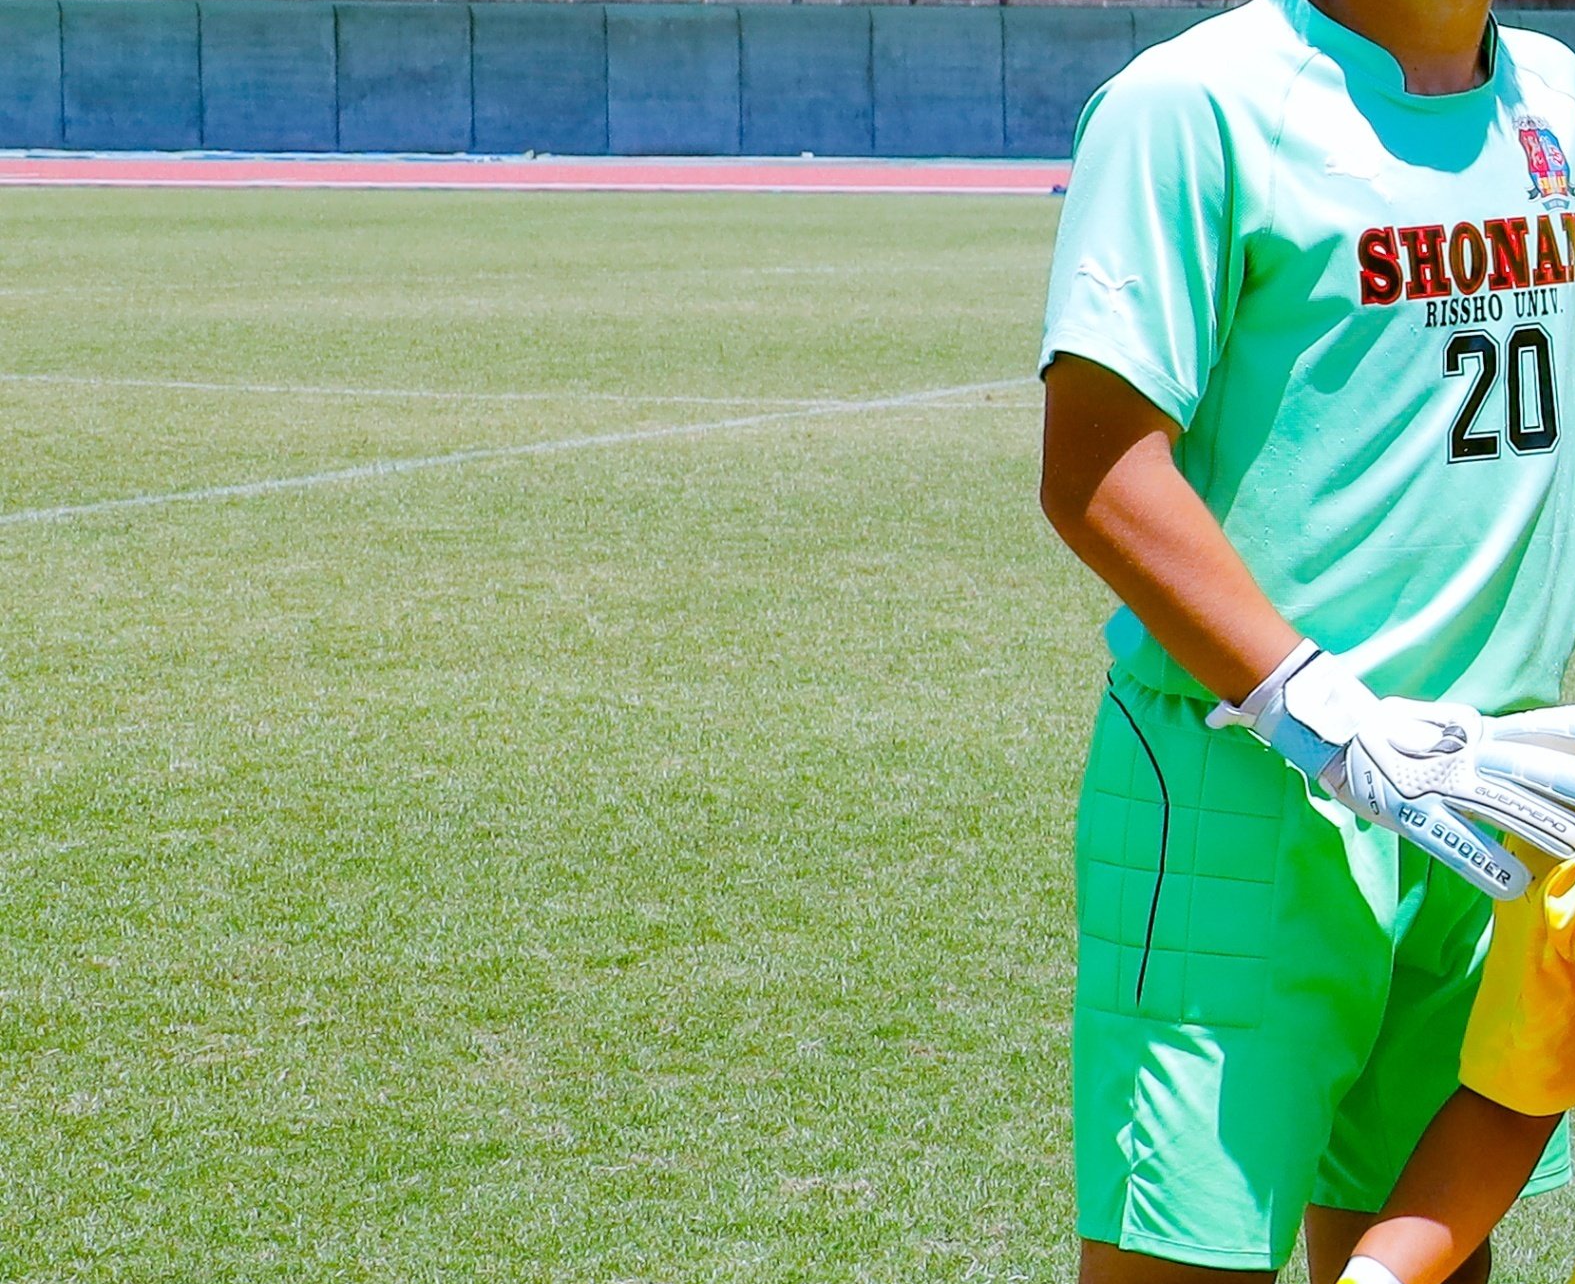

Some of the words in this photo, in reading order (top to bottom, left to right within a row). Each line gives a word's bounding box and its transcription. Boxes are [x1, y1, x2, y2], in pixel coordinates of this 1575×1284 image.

[1425, 294, 1503, 327] RISSHO
[1514, 288, 1564, 317] UNIV.
[1443, 322, 1561, 465] 20
[1364, 770, 1379, 815] PRO
